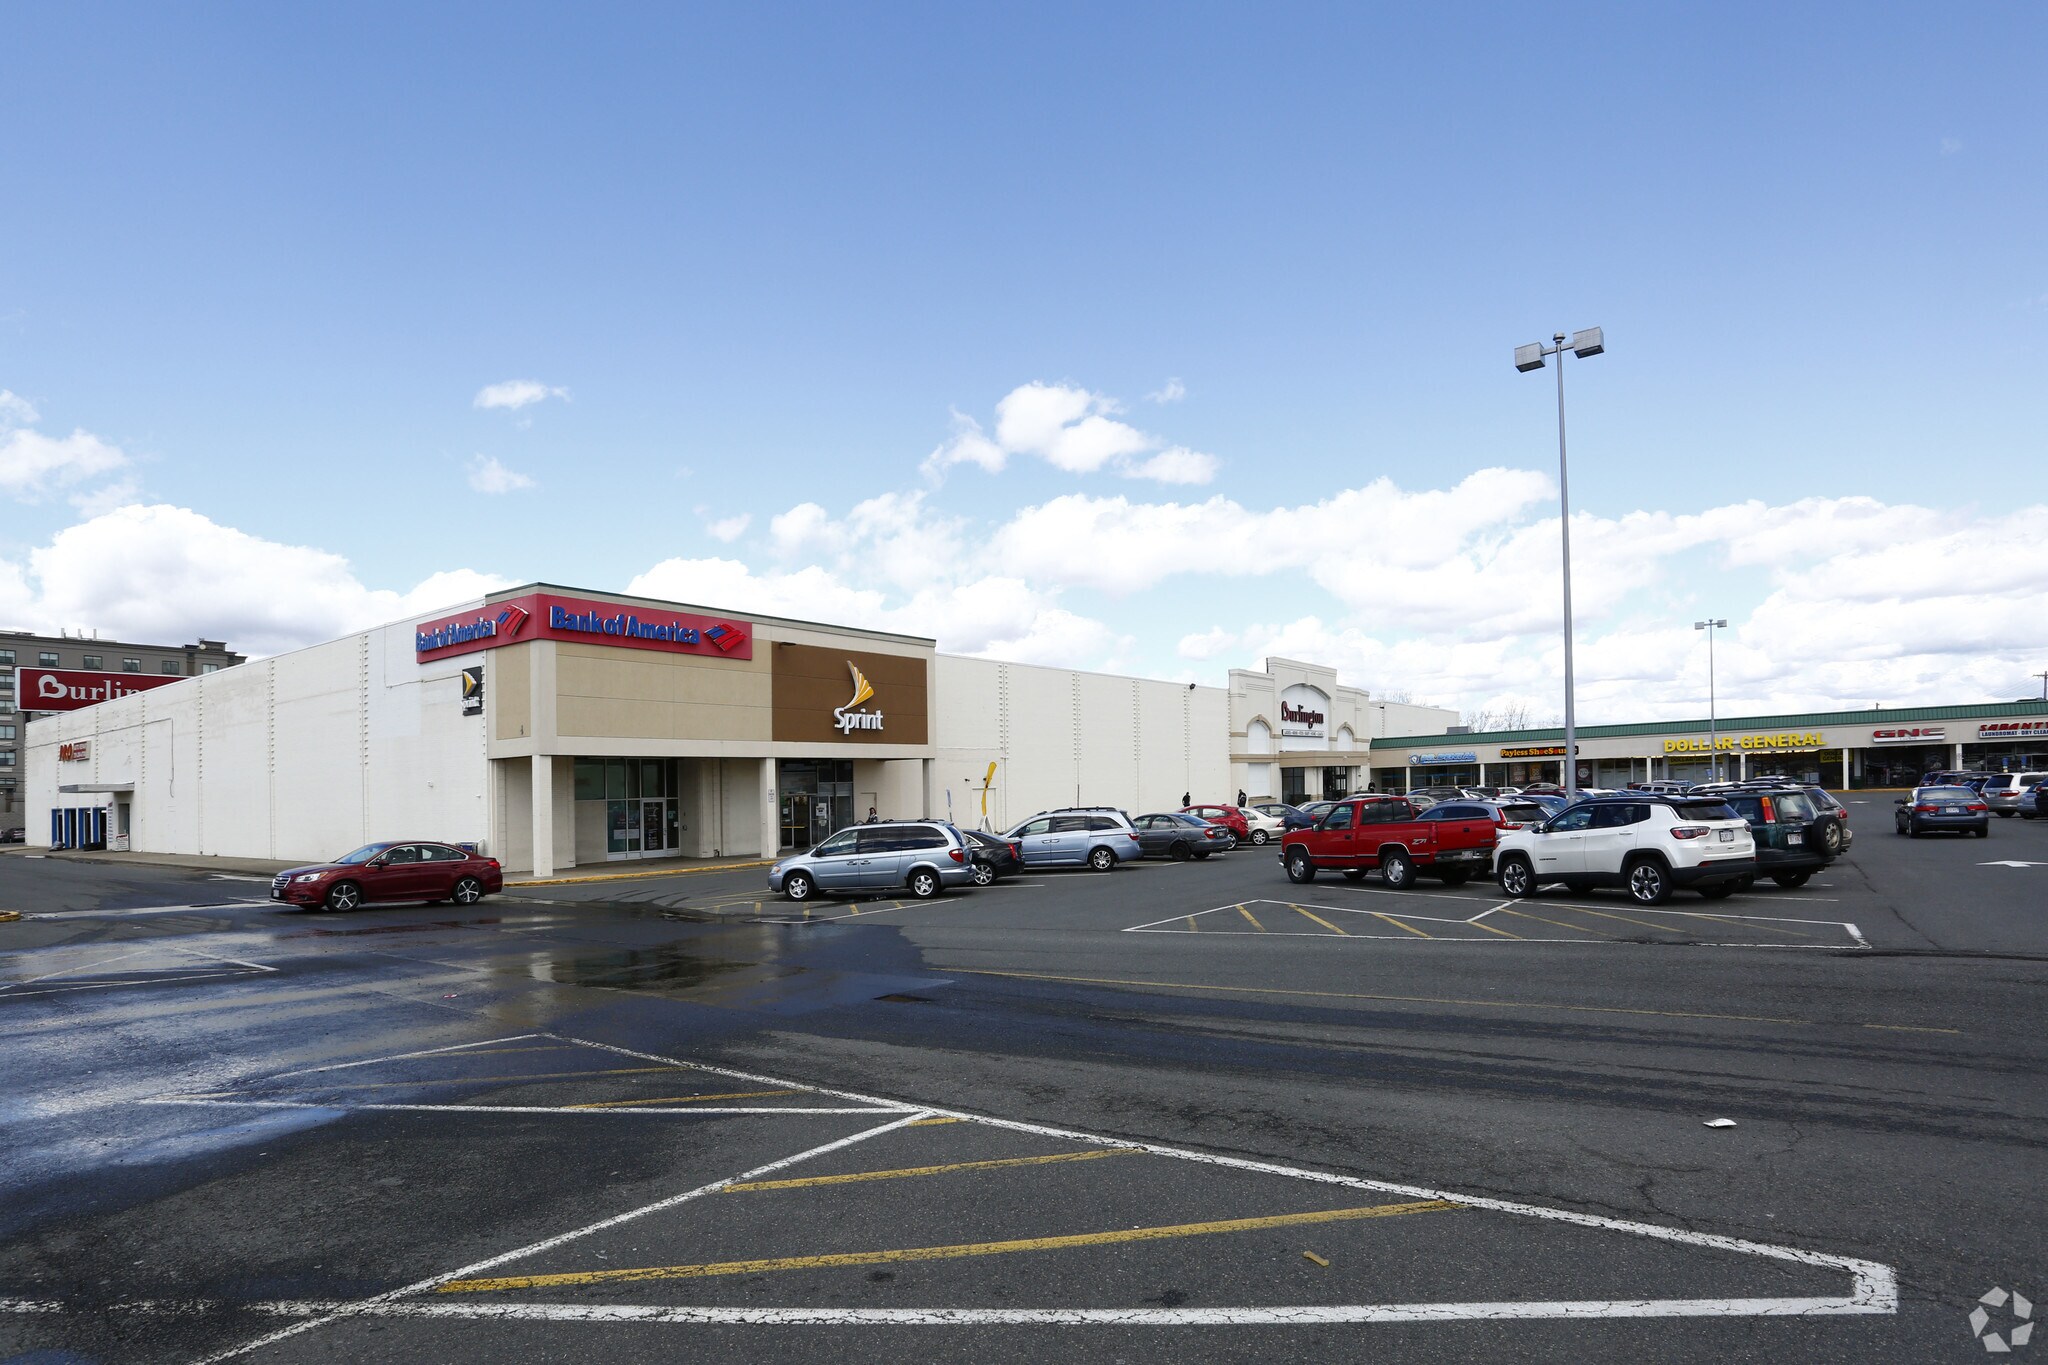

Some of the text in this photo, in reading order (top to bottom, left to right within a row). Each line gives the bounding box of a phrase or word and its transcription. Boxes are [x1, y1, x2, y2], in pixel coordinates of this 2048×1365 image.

[416, 617, 496, 652] Bank of America
[550, 606, 700, 644] Bank of America
[833, 707, 883, 734] Sprint
[1281, 700, 1324, 729] Burlington
[1873, 727, 1945, 738] GNC
[1979, 722, 2048, 732] SABANT
[1501, 747, 1577, 758] Payless ShoeSour
[1664, 732, 1827, 752] DOLLAR GENERAL
